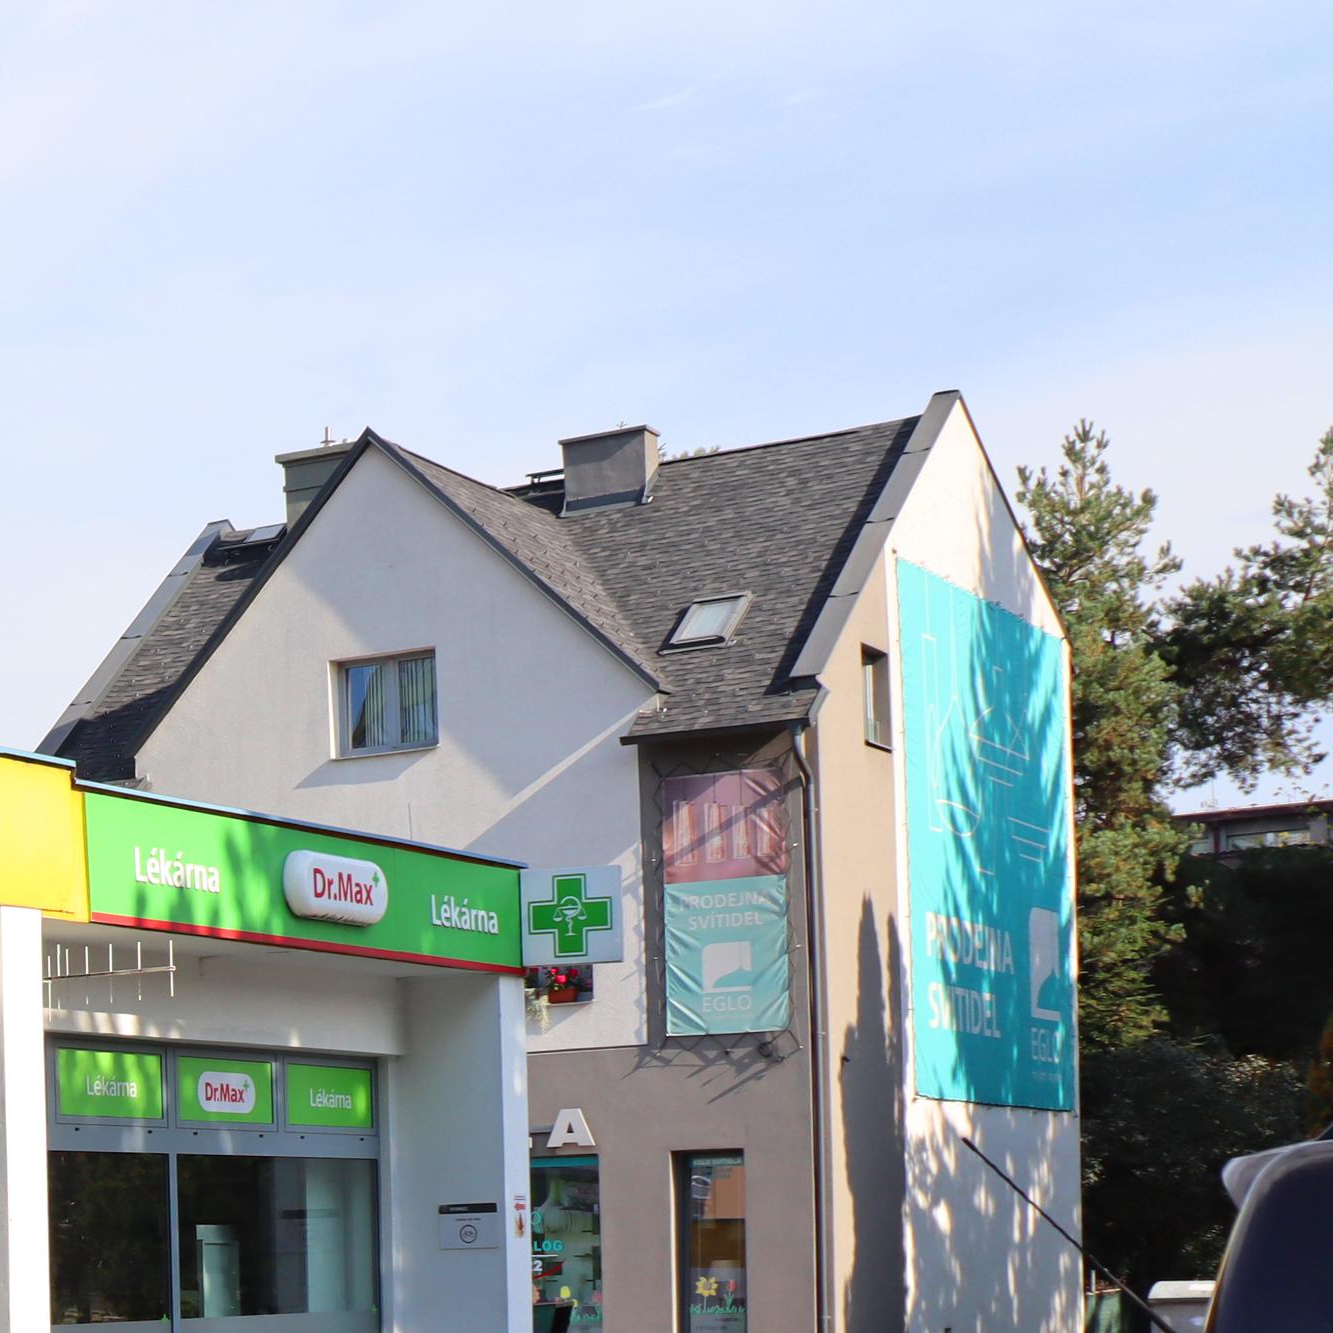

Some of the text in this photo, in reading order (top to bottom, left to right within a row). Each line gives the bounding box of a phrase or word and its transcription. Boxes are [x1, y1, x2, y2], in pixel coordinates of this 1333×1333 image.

[134, 847, 221, 894] Lékárna
[313, 867, 374, 907] Dr.Max
[431, 894, 499, 935] Lékárna
[703, 995, 751, 1013] EGLO
[1031, 1027, 1061, 1064] EGLO
[86, 1074, 138, 1098] Lékárna
[204, 1081, 246, 1104] Dr.Max
[309, 1088, 353, 1110] Lékárna
